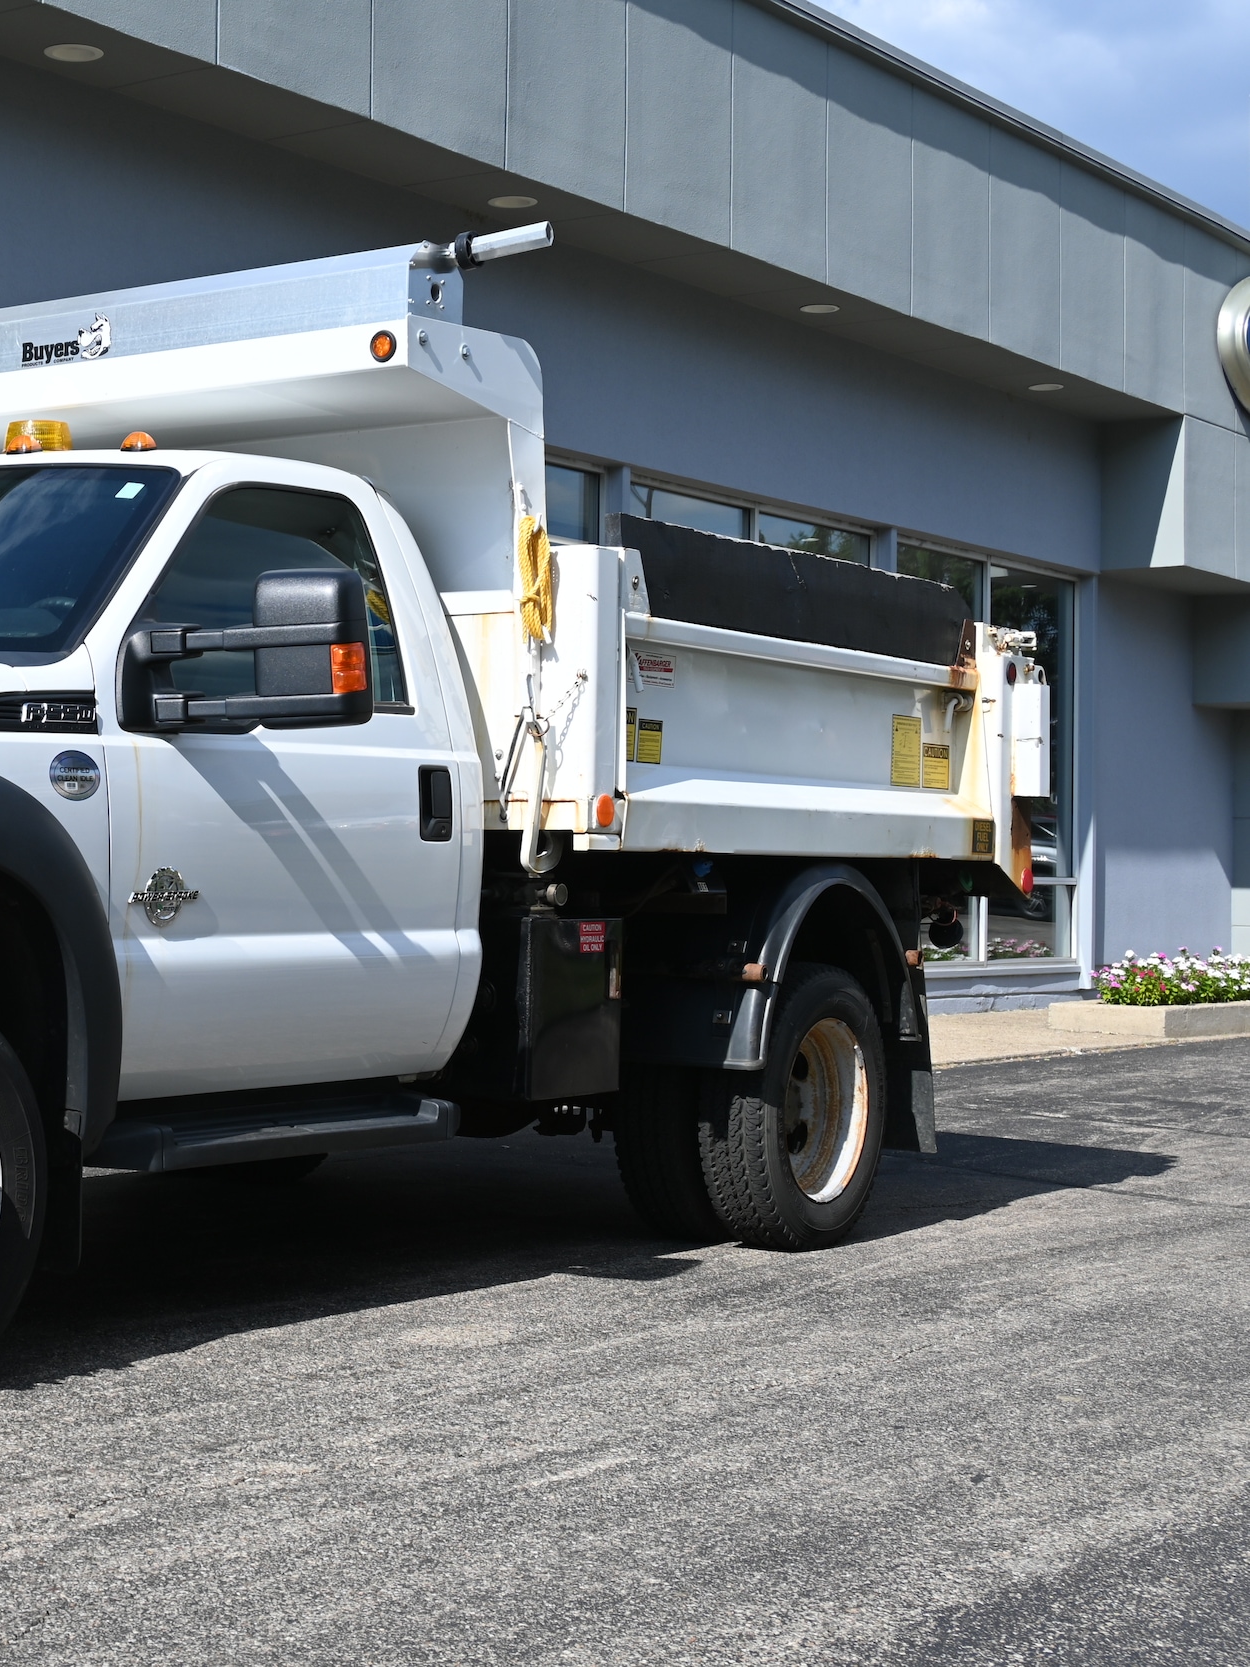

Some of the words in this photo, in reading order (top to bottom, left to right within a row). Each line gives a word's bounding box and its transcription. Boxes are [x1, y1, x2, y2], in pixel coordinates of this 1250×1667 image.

[22, 340, 80, 364] Buyers
[22, 360, 43, 368] PRODUCTS
[53, 356, 75, 364] COMPANY
[924, 746, 948, 759] CAUTION
[59, 766, 90, 774] CERTIFIED
[57, 774, 78, 782] CLEAN
[975, 821, 992, 832] DIESEL
[977, 831, 990, 842] FUEL
[976, 842, 989, 852] ONLY
[580, 935, 605, 943] HYDRAULIC
[591, 943, 602, 951] ONLY
